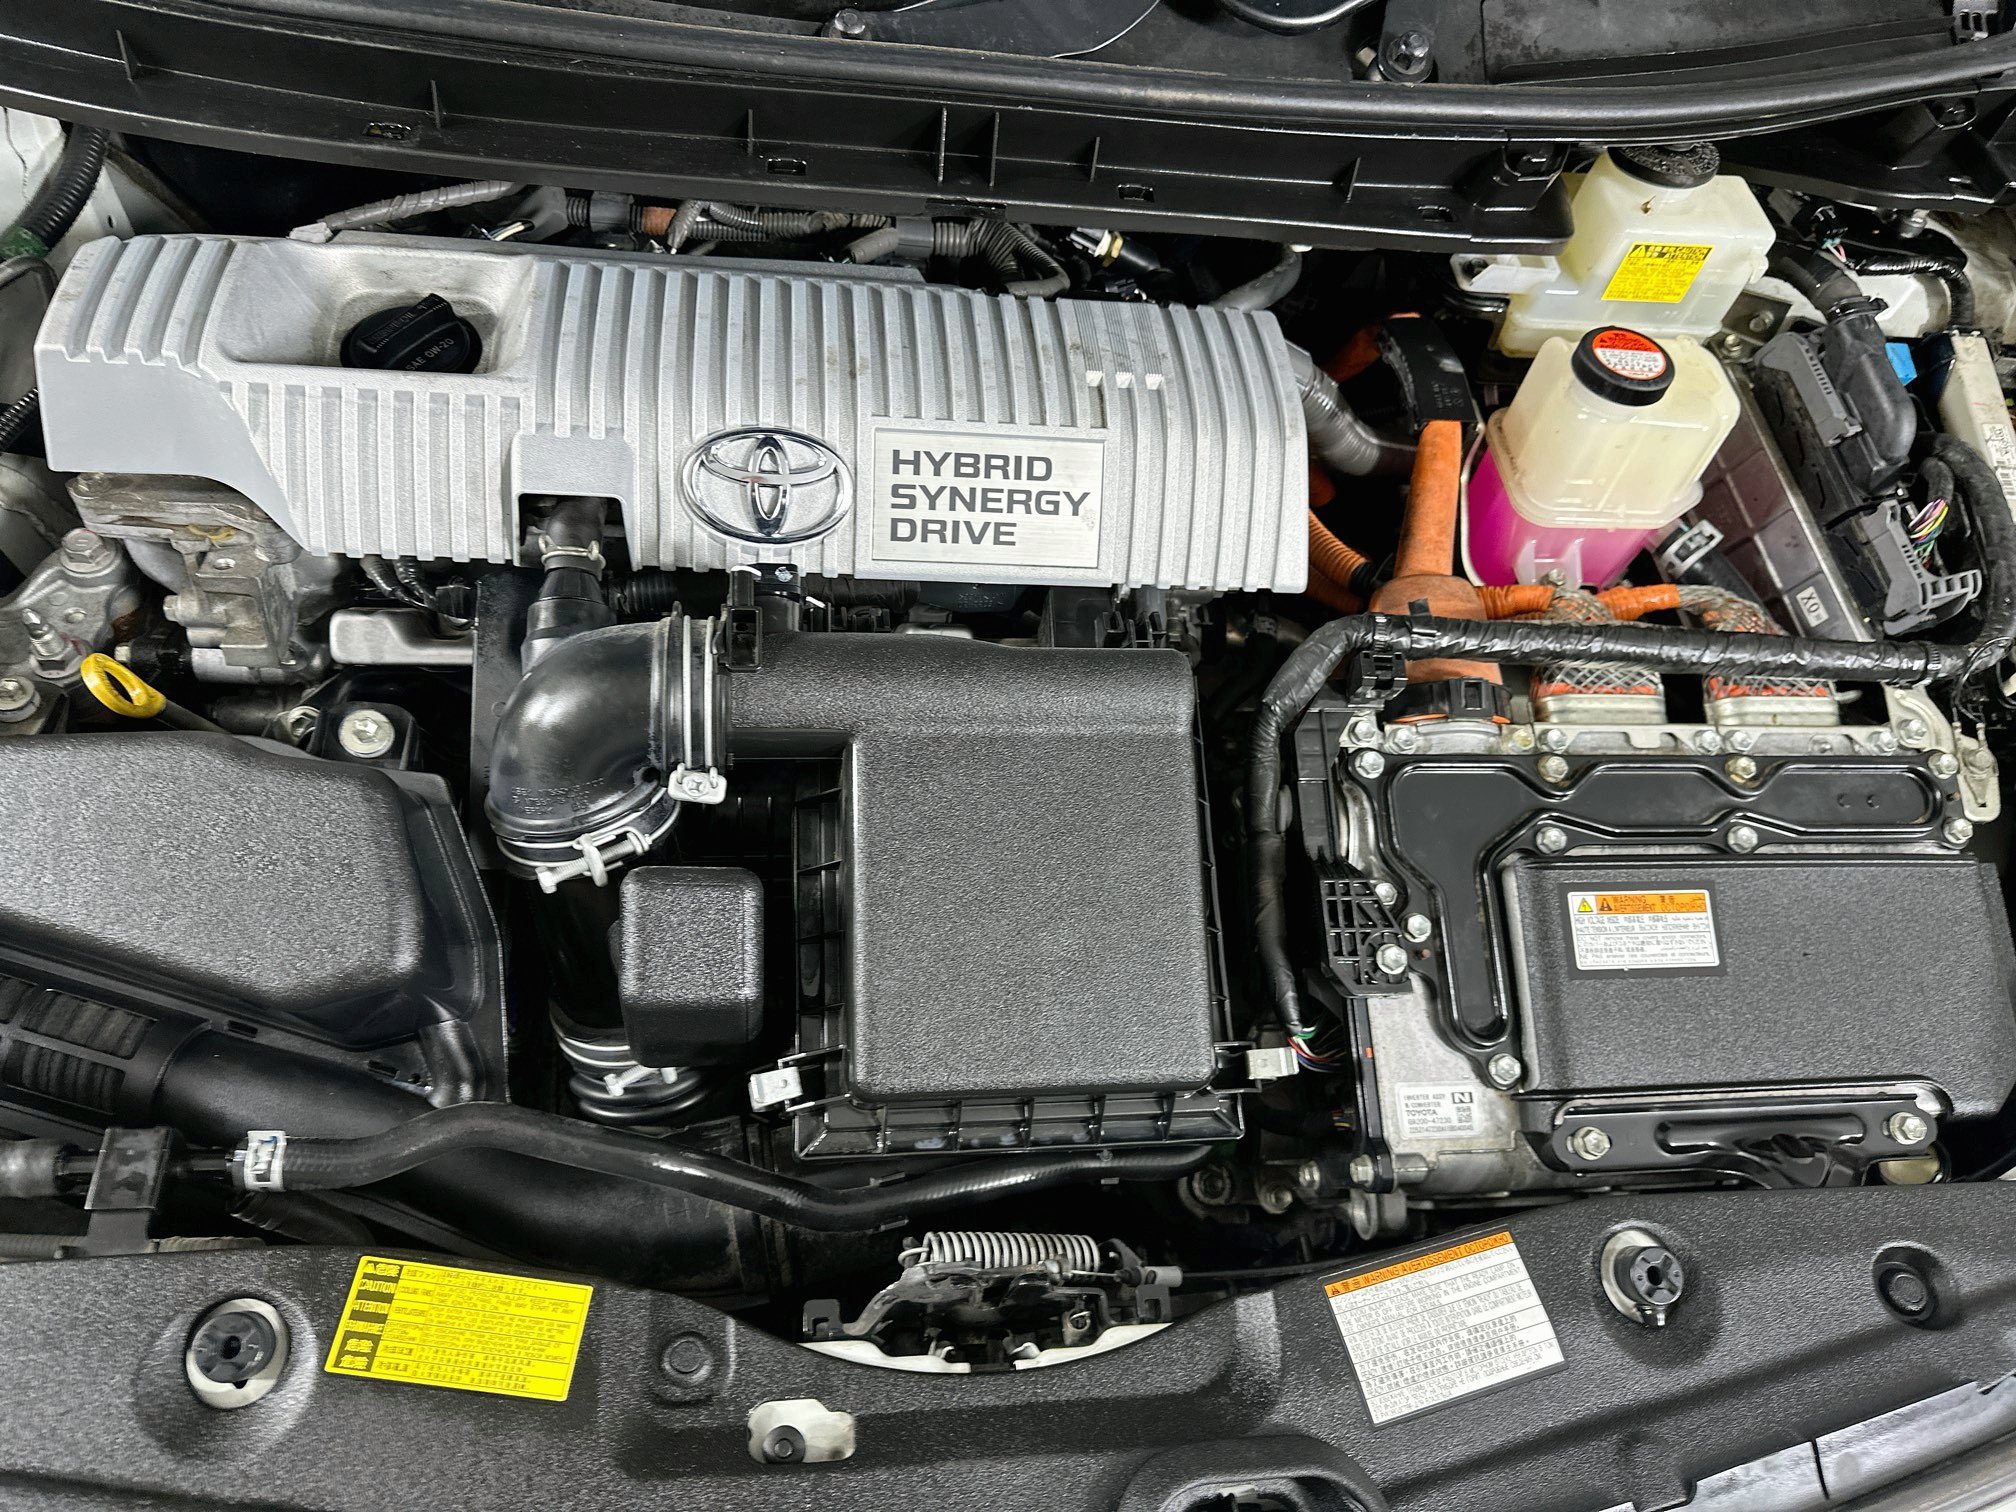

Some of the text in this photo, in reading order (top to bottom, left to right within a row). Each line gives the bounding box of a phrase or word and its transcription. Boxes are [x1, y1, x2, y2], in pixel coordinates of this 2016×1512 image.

[405, 356, 426, 370] SAE
[892, 449, 1052, 482] HYBRID
[890, 484, 1091, 516] SYNERGY
[890, 517, 1018, 547] DRIVE
[1361, 1266, 1399, 1284] WARNING
[1400, 1247, 1462, 1273] AVERTISSEMENT
[358, 1278, 397, 1293] CAUTION
[1349, 1306, 1366, 1318] AVOID
[1389, 1293, 1410, 1305] PLEASE
[1411, 1288, 1426, 1298] MAKE
[1444, 1278, 1458, 1288] THAT
[1489, 1264, 1505, 1274] LAMP
[1353, 1312, 1373, 1324] METER
[1394, 1299, 1415, 1311] BEFORE
[1416, 1291, 1442, 1304] WORKING
[1462, 1278, 1482, 1290] ENGINE
[1482, 1266, 1522, 1284] COMPARTMENT
